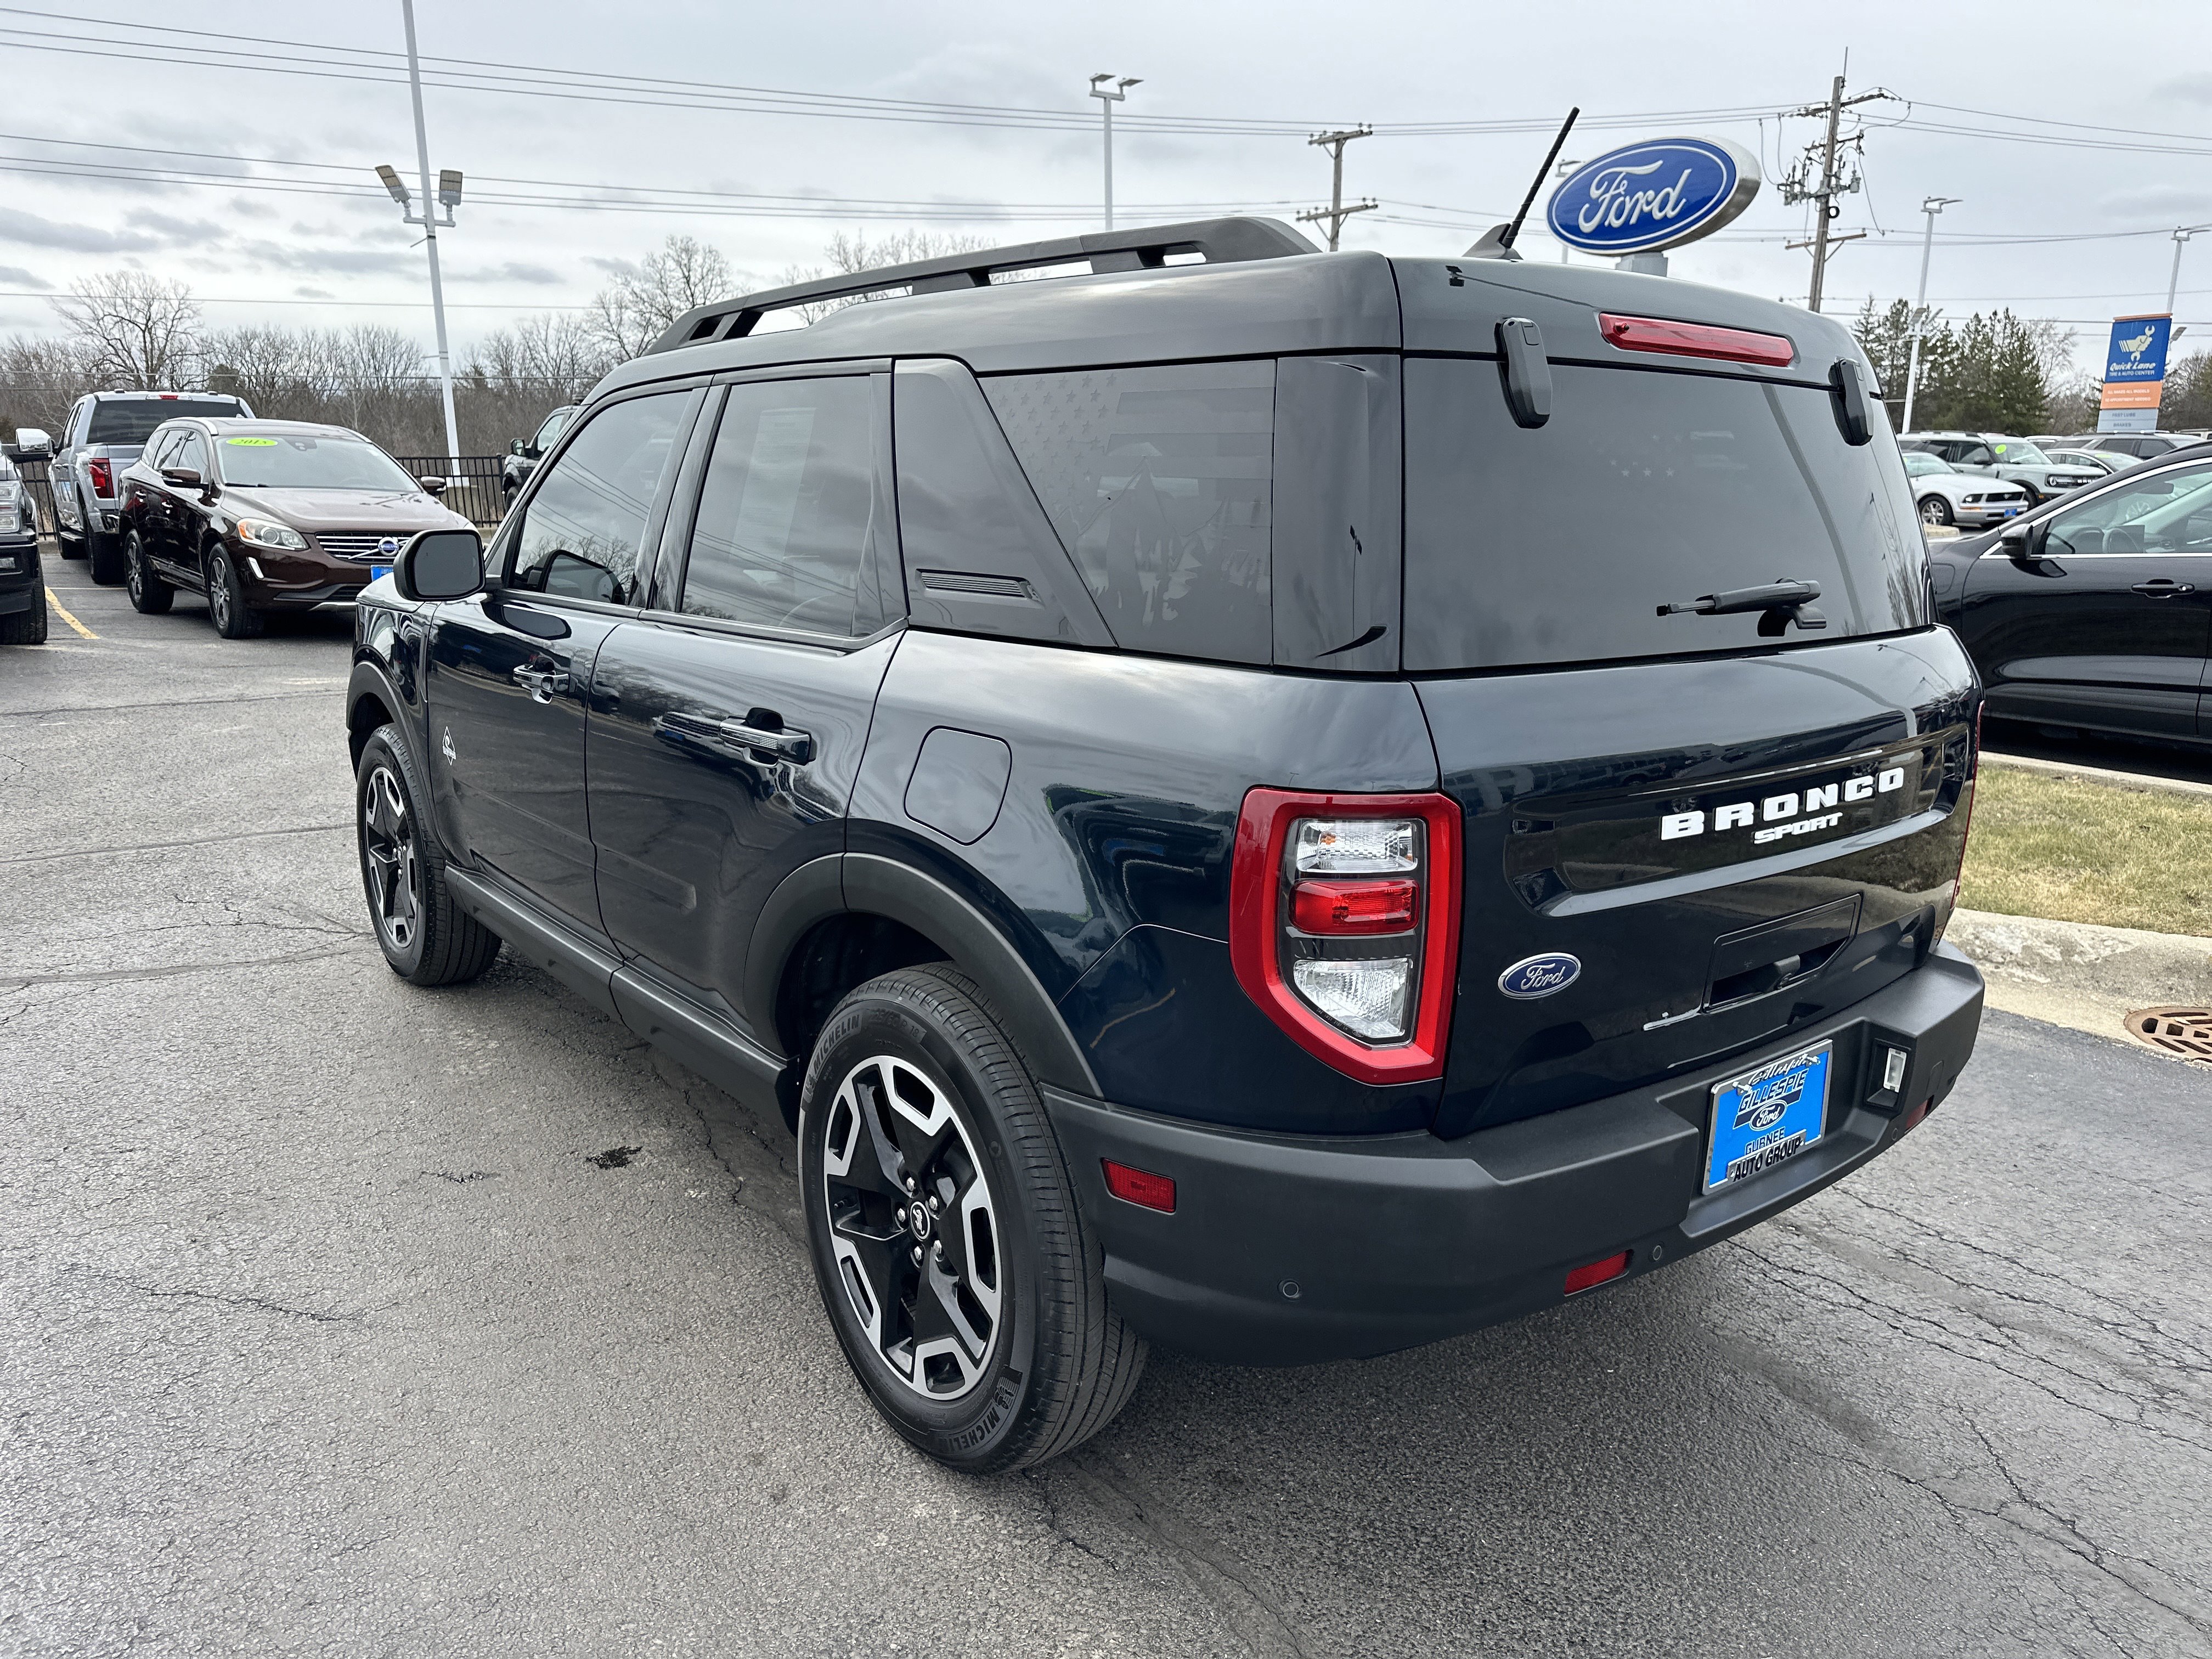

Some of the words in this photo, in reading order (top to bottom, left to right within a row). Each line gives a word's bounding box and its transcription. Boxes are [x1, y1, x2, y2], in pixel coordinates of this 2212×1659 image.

[1578, 159, 1692, 234] Ford
[2110, 362, 2132, 371] Quick
[2132, 362, 2156, 370] Lane
[1660, 767, 1904, 840] BRONCO
[1753, 812, 1843, 844] SPORT
[1520, 963, 1566, 990] Ford
[813, 1014, 860, 1075] MICHELIN
[1739, 1068, 1809, 1113] GILLESPIE
[1756, 1105, 1781, 1127] Ford
[1733, 1151, 1763, 1182] AUTO
[1765, 1135, 1801, 1167] GROUP
[1745, 1126, 1786, 1155] GURNEE
